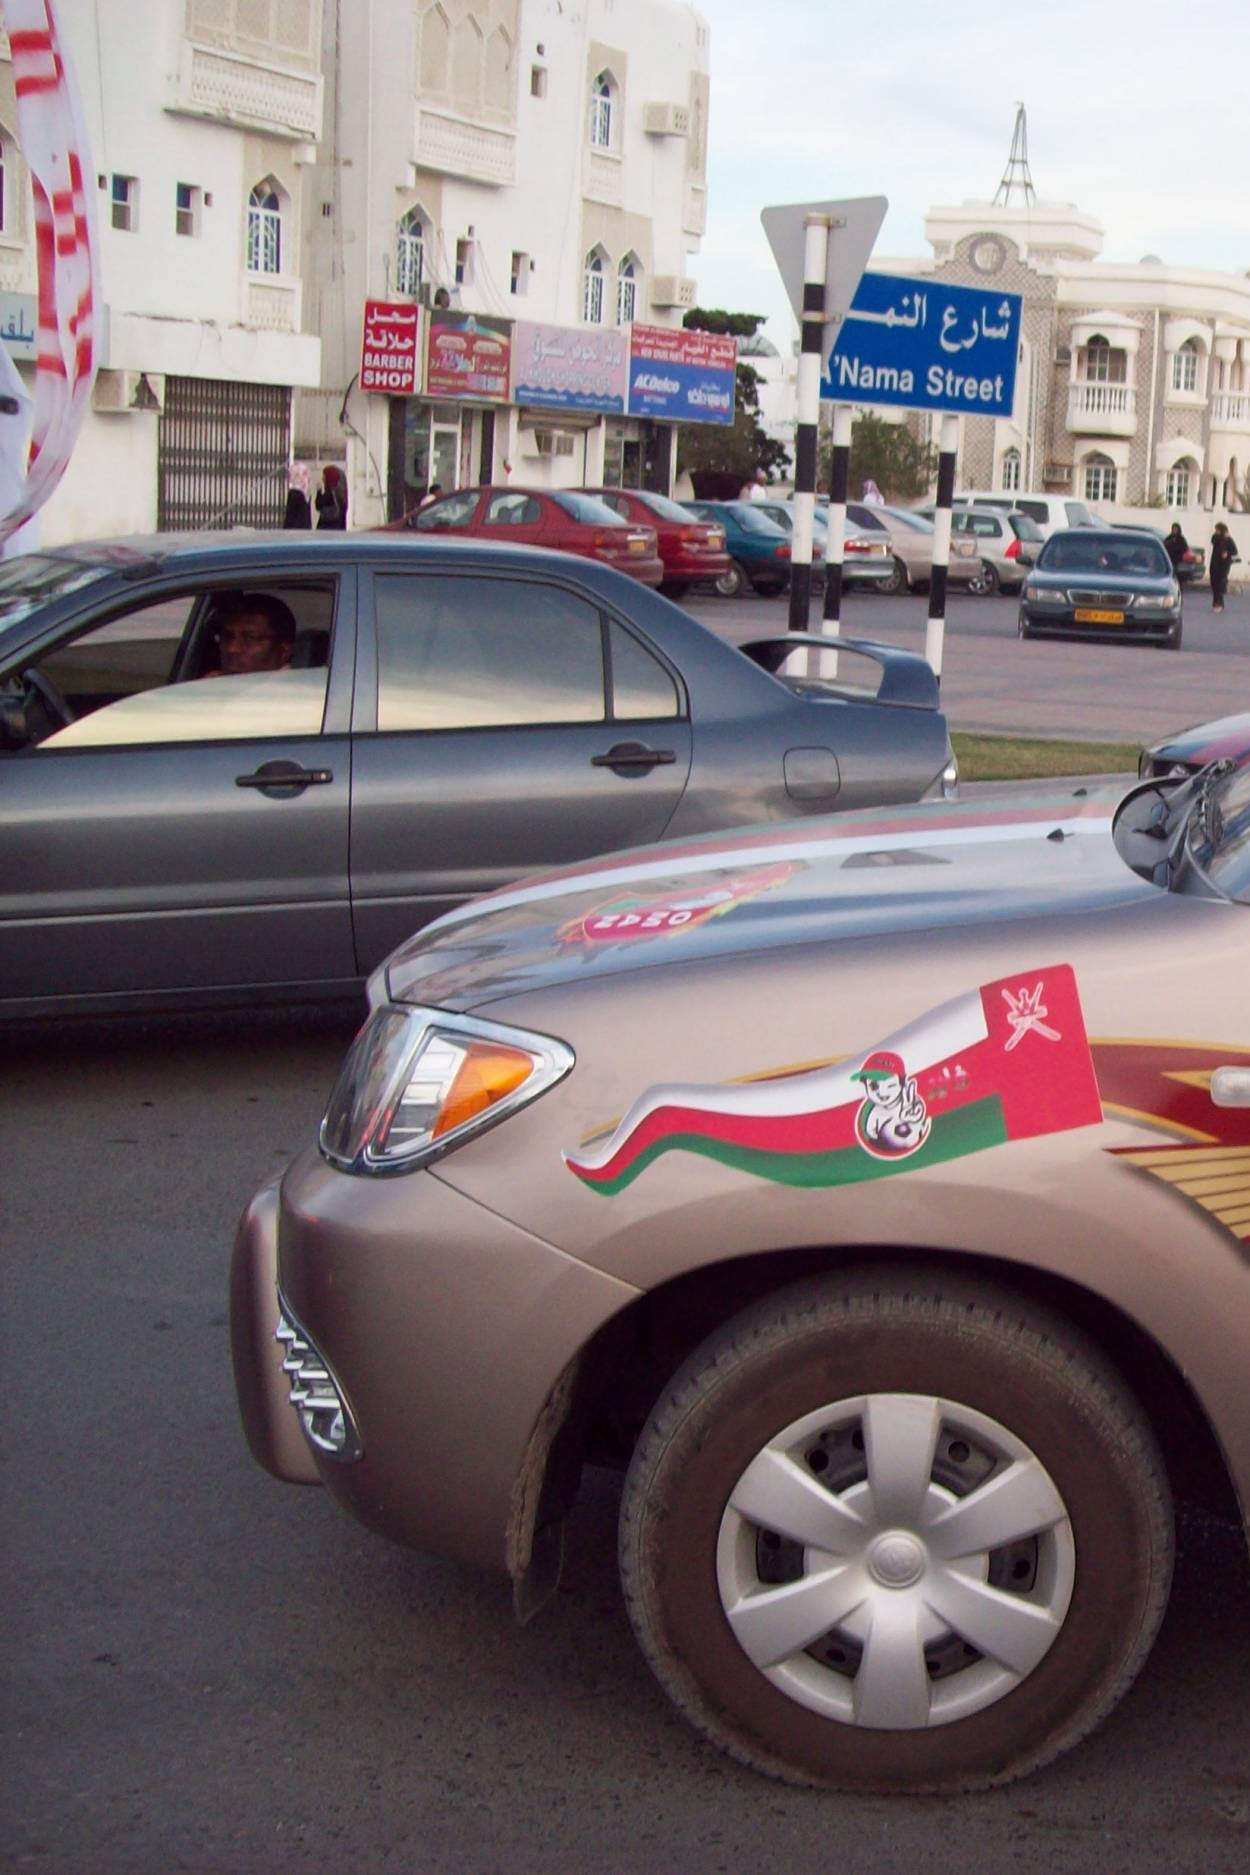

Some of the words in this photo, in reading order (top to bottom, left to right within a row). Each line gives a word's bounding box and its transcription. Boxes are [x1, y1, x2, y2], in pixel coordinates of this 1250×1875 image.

[366, 306, 416, 325] محل
[847, 292, 928, 328] النم
[940, 300, 1011, 353] شارع
[365, 328, 414, 350] حلاقة
[364, 352, 413, 369] BARBER
[363, 370, 412, 387] SHOP
[634, 373, 680, 395] ACDelco
[926, 364, 1004, 402] Street
